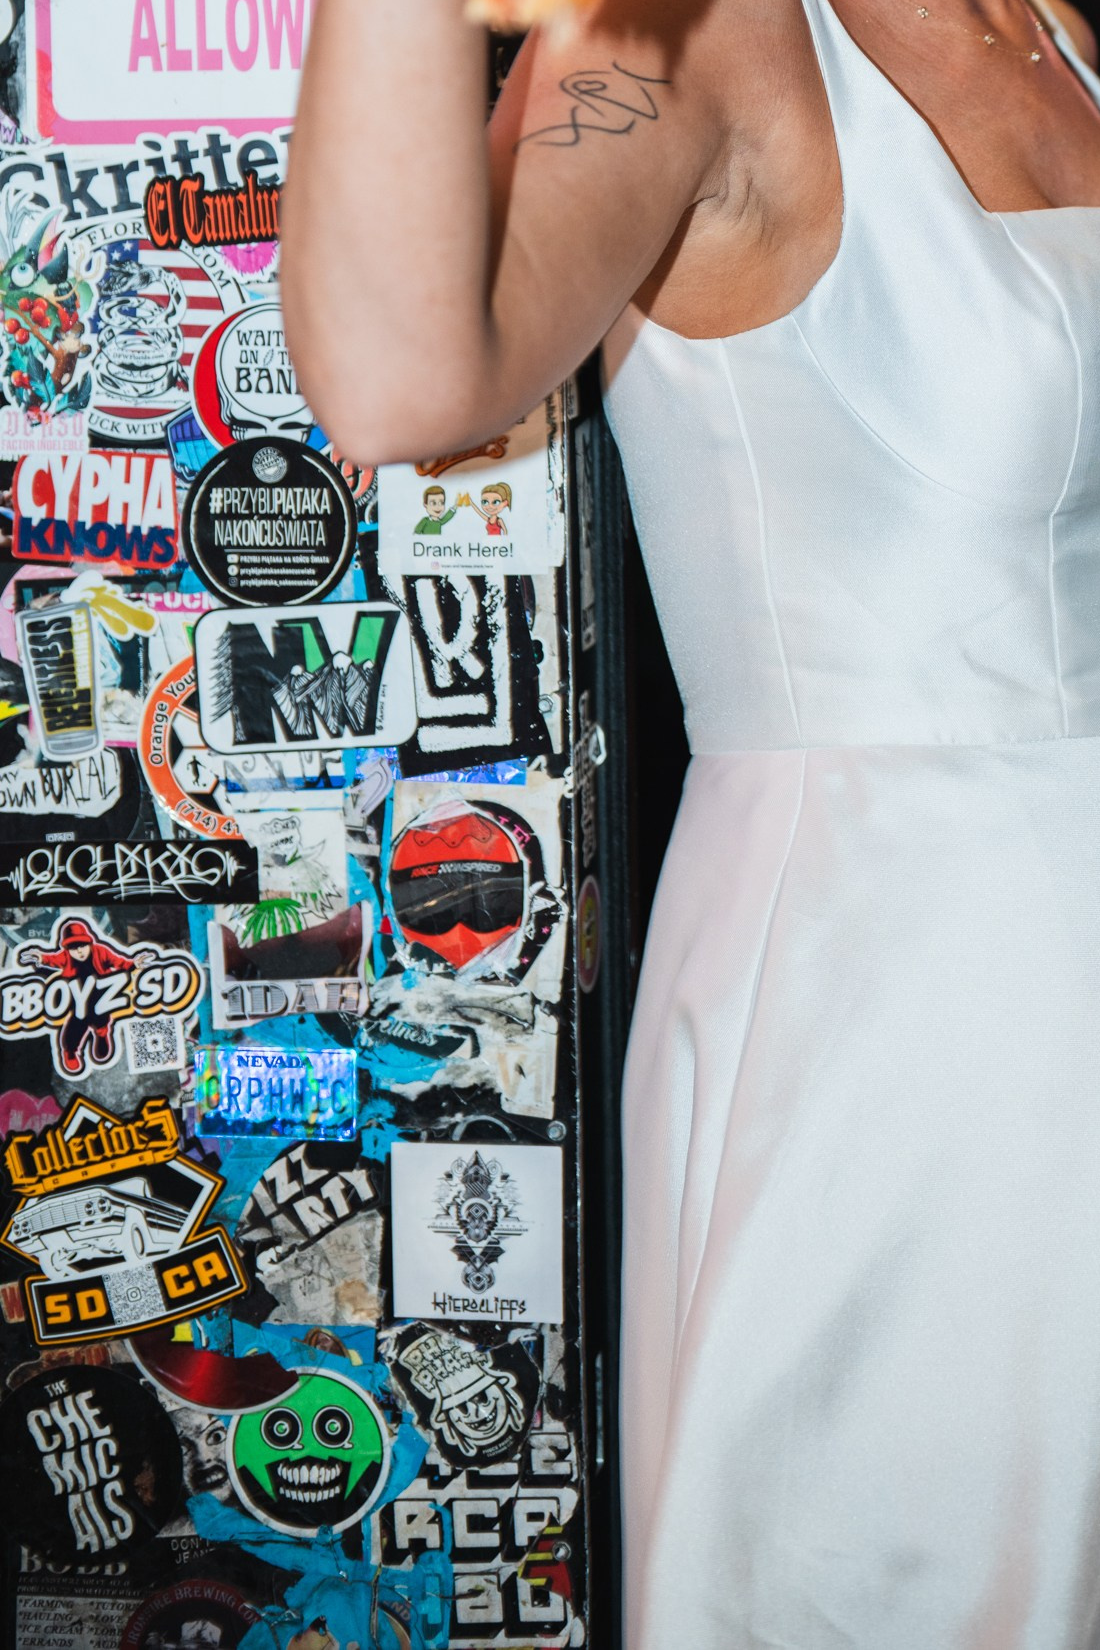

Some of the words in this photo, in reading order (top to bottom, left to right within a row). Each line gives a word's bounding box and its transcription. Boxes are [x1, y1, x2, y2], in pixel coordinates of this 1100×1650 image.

[147, 177, 179, 246] El
[236, 329, 287, 348] WAIT
[239, 349, 259, 365] ON
[82, 412, 120, 435] UCK
[17, 453, 175, 535] CYPHA
[18, 515, 175, 564] KNOWS
[413, 540, 463, 559] Drank
[468, 541, 514, 559] Here!
[150, 701, 169, 766] Orange
[174, 799, 218, 832] (714)
[2, 972, 129, 1023] BBOYZ
[136, 964, 191, 1007] SD
[236, 1055, 315, 1069] NEVADA
[45, 1289, 109, 1325] SD
[162, 1251, 229, 1300] CA
[44, 1379, 70, 1398] THE
[26, 1390, 112, 1453] CHE
[42, 1437, 120, 1496] MIC
[68, 1480, 134, 1554] ALS
[21, 1611, 74, 1622] HAULING
[174, 1585, 237, 1608] BREWING
